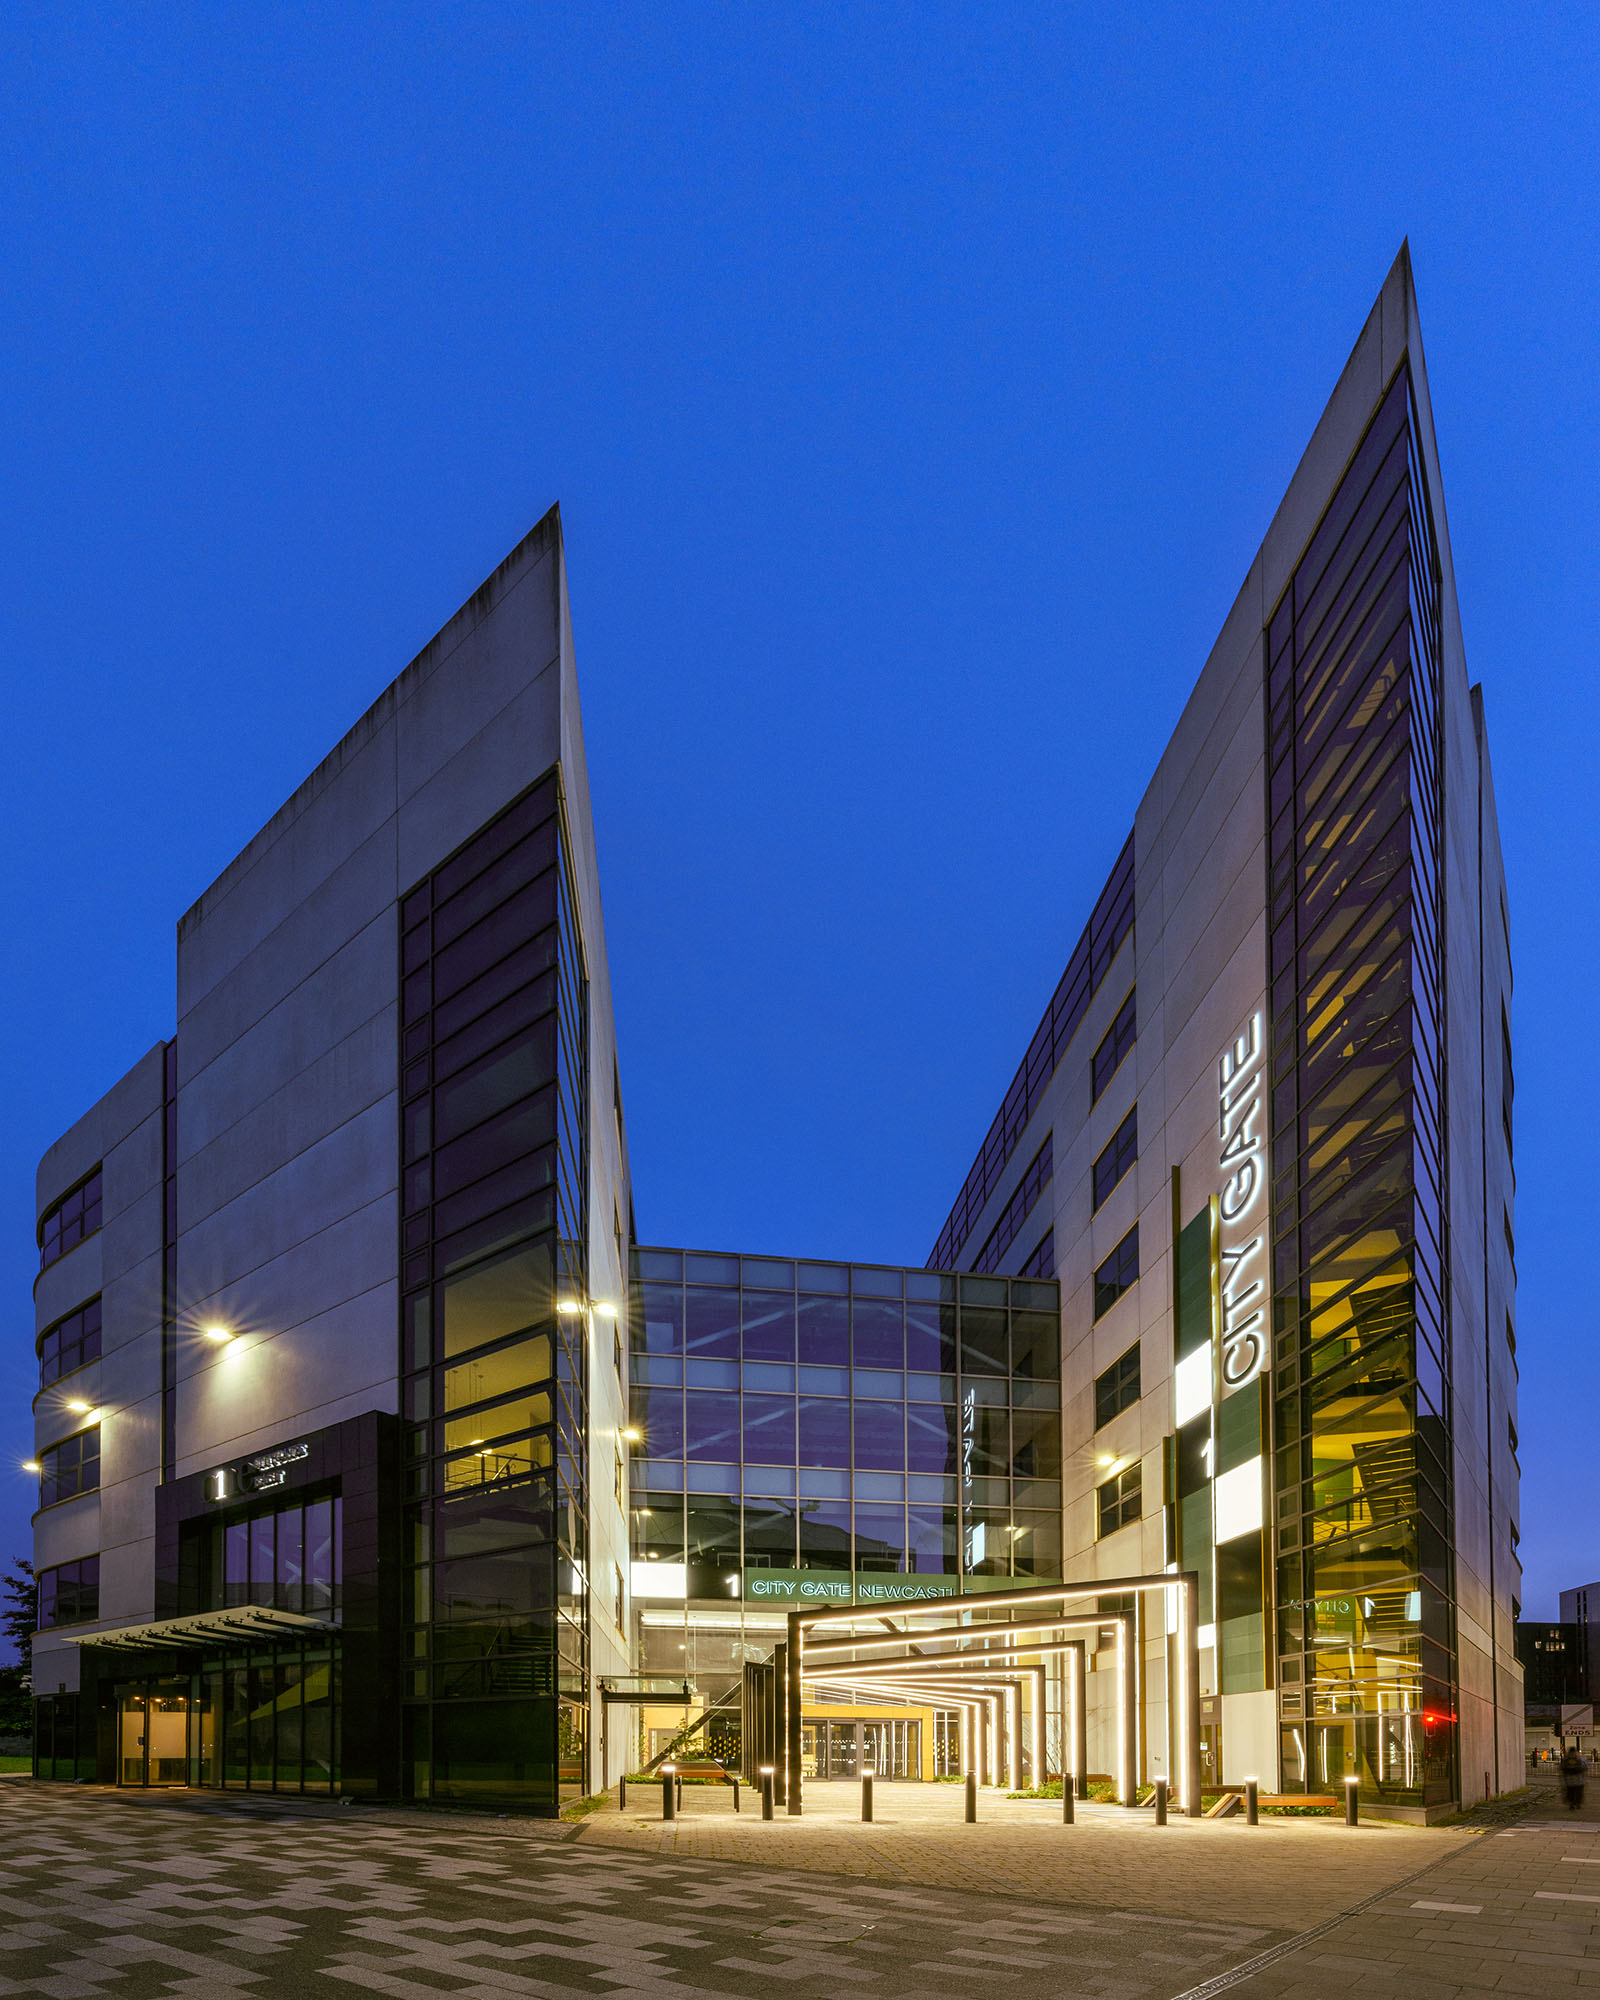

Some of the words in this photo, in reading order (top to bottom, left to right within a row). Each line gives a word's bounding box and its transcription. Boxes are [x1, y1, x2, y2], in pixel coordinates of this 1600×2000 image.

[1219, 1013, 1262, 1224] GATE
[1221, 1236, 1263, 1386] CITY
[725, 1574, 739, 1597] 1
[752, 1580, 796, 1595] CITY
[800, 1581, 851, 1597] GATE
